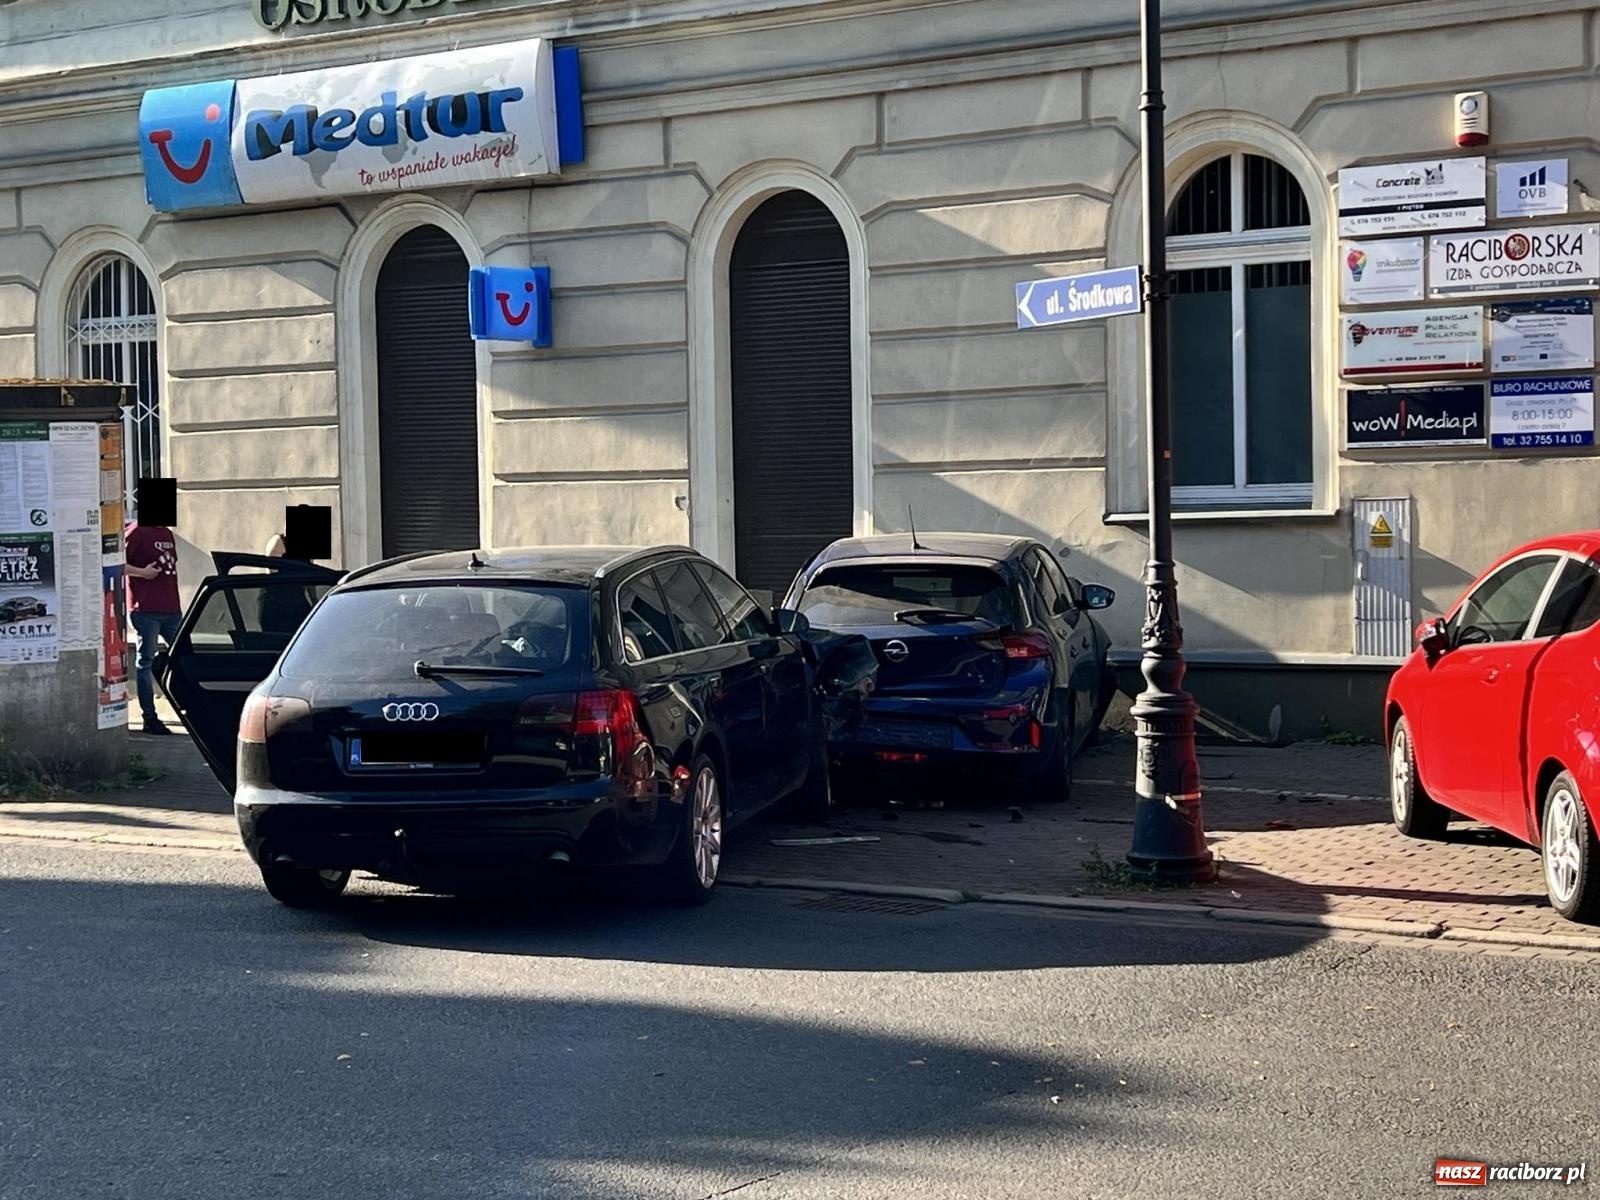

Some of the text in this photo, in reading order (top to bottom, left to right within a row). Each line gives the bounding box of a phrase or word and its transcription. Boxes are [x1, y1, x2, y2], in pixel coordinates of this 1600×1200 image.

[244, 87, 524, 161] Medtur
[358, 134, 517, 189] to wspaniałe wakacje!
[1375, 176, 1421, 188] Concrete
[1518, 187, 1546, 199] OVB
[1446, 233, 1584, 263] RACIBORSKA
[1446, 260, 1583, 281] IZBA GOSPODARCZA
[1046, 280, 1133, 316] ul. Środkowa
[1425, 314, 1469, 322] AGENCJA
[1425, 323, 1459, 331] PUBLIC
[1425, 331, 1477, 339] RELATIONS
[1493, 379, 1591, 393] BIURO RACHUNKOWE
[1511, 408, 1573, 421] 8:00-15:00
[1503, 436, 1517, 446] tel.
[1520, 435, 1532, 446] 32
[1535, 434, 1552, 445] 755
[1556, 434, 1567, 444] 14
[0, 560, 39, 573] ETRZ
[7, 571, 40, 581] LIPCA
[0, 624, 52, 635] NCERTY
